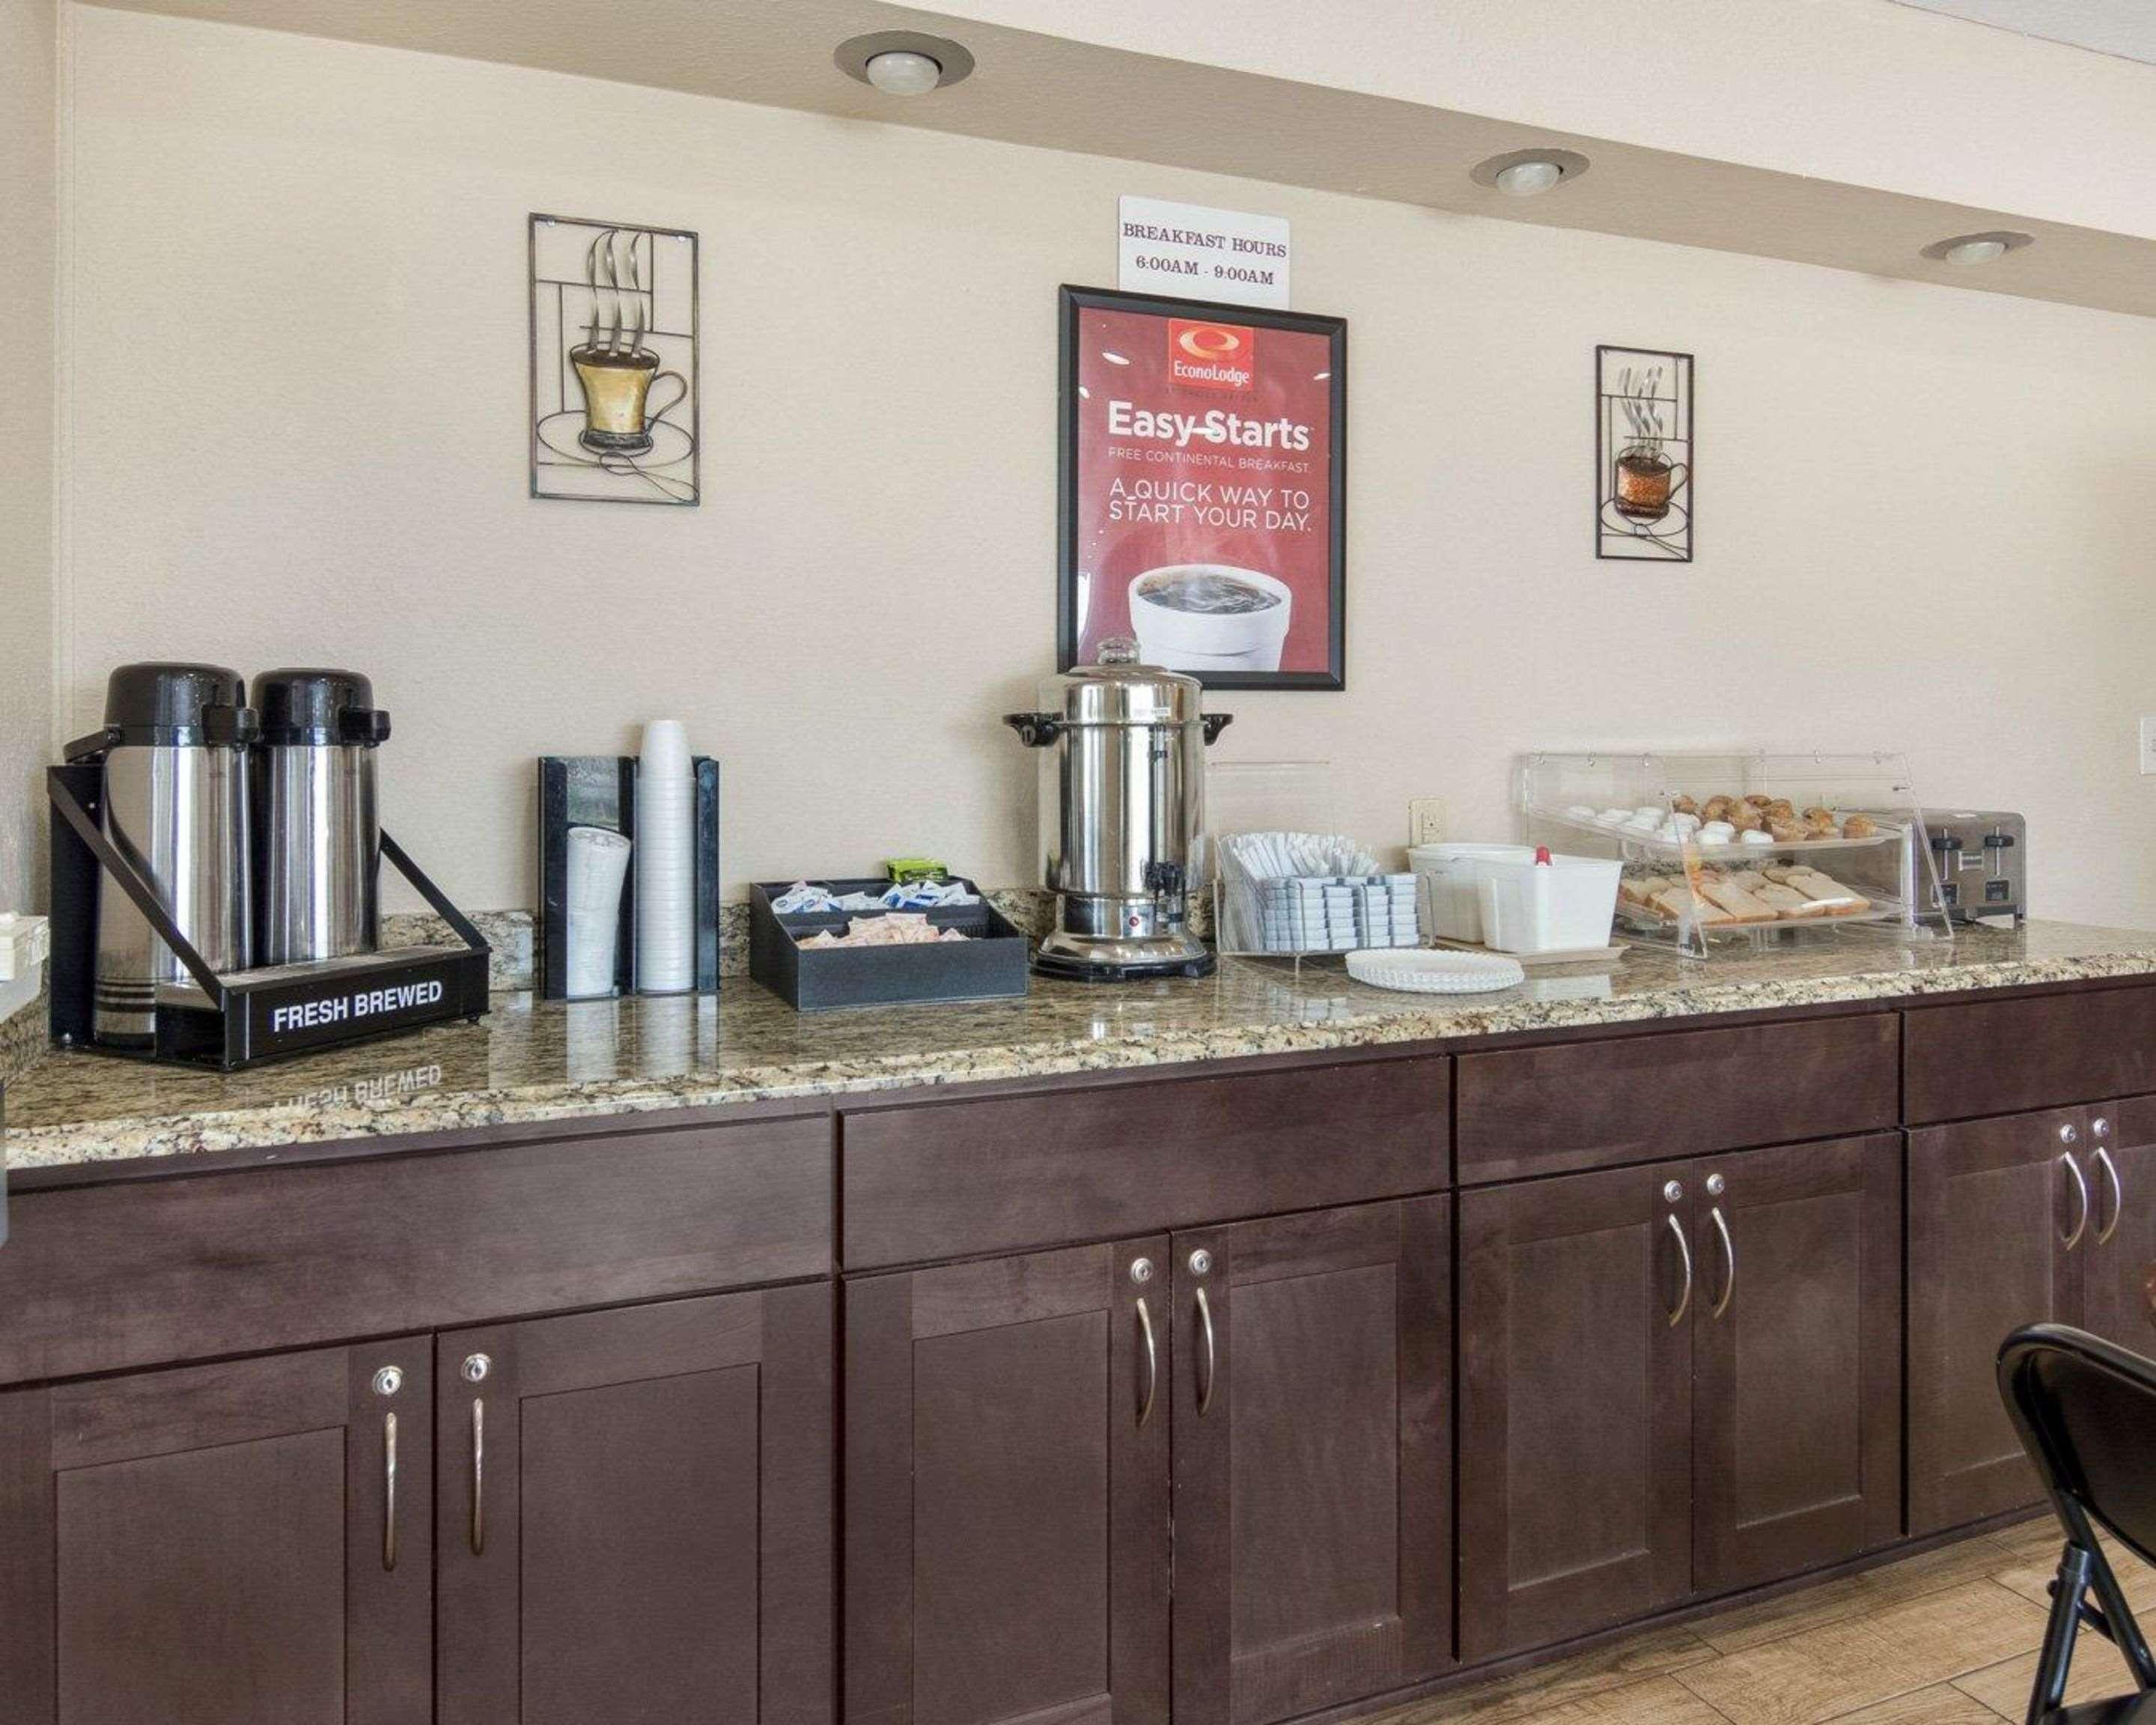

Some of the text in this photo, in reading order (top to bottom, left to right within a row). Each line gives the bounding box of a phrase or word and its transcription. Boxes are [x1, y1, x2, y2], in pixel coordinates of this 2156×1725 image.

[1123, 222, 1287, 258] BREAKFAST HOURS
[1136, 255, 1199, 276] 6:00AM
[1214, 264, 1274, 285] 9:00AM
[1173, 359, 1250, 387] EconoLodge
[1108, 446, 1142, 462] FREE
[1145, 450, 1234, 469] CONTINENTAL
[1109, 477, 1310, 510] A QUICK WAY TO
[1109, 500, 1311, 532] START YOUR DAY.
[273, 980, 442, 1032] FRESH BREWED
